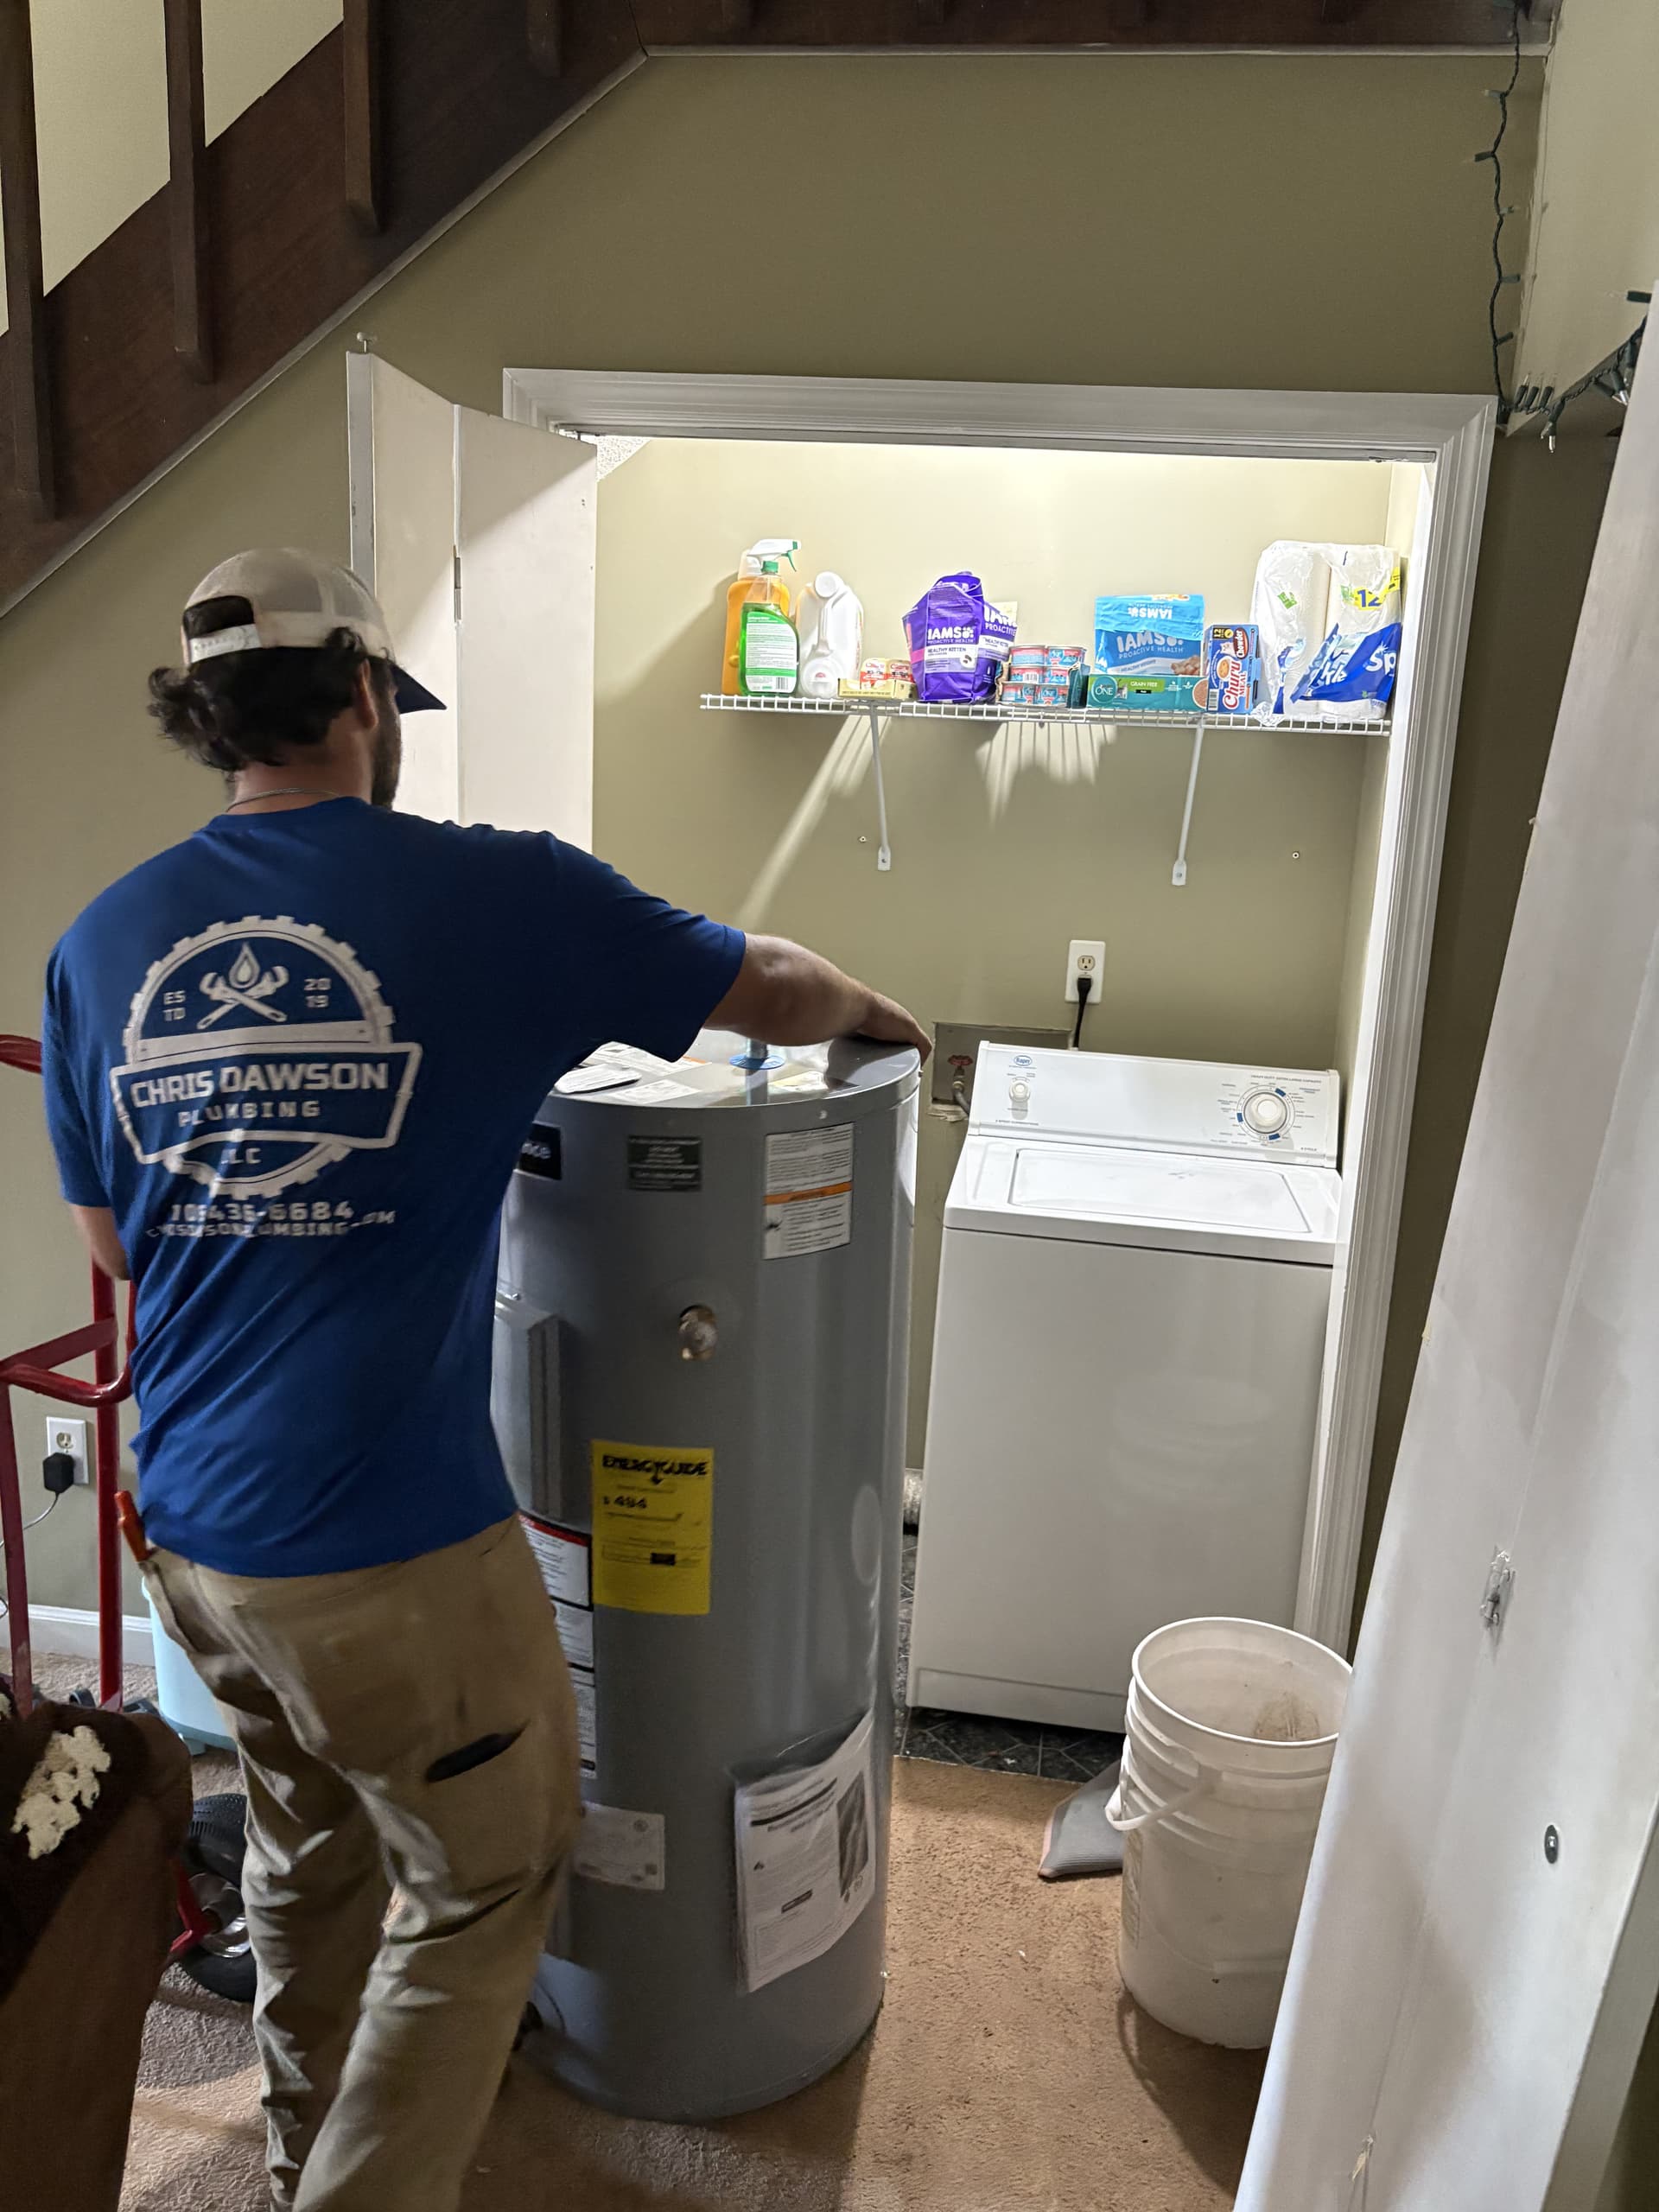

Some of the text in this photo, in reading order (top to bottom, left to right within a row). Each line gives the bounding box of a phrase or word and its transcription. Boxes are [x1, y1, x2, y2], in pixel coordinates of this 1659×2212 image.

[1139, 607, 1173, 620] IAMS
[927, 626, 963, 640] IAMS
[1214, 628, 1222, 638] 12
[1116, 631, 1165, 652] IAMS
[1119, 646, 1154, 659] PROACTIVE
[1095, 685, 1114, 696] ONE
[1223, 660, 1241, 709] Churu
[303, 977, 332, 991] 20
[163, 990, 186, 1005] ES
[130, 1062, 390, 1108] CHRIS DAWSON
[177, 1100, 321, 1128] PLUMBING
